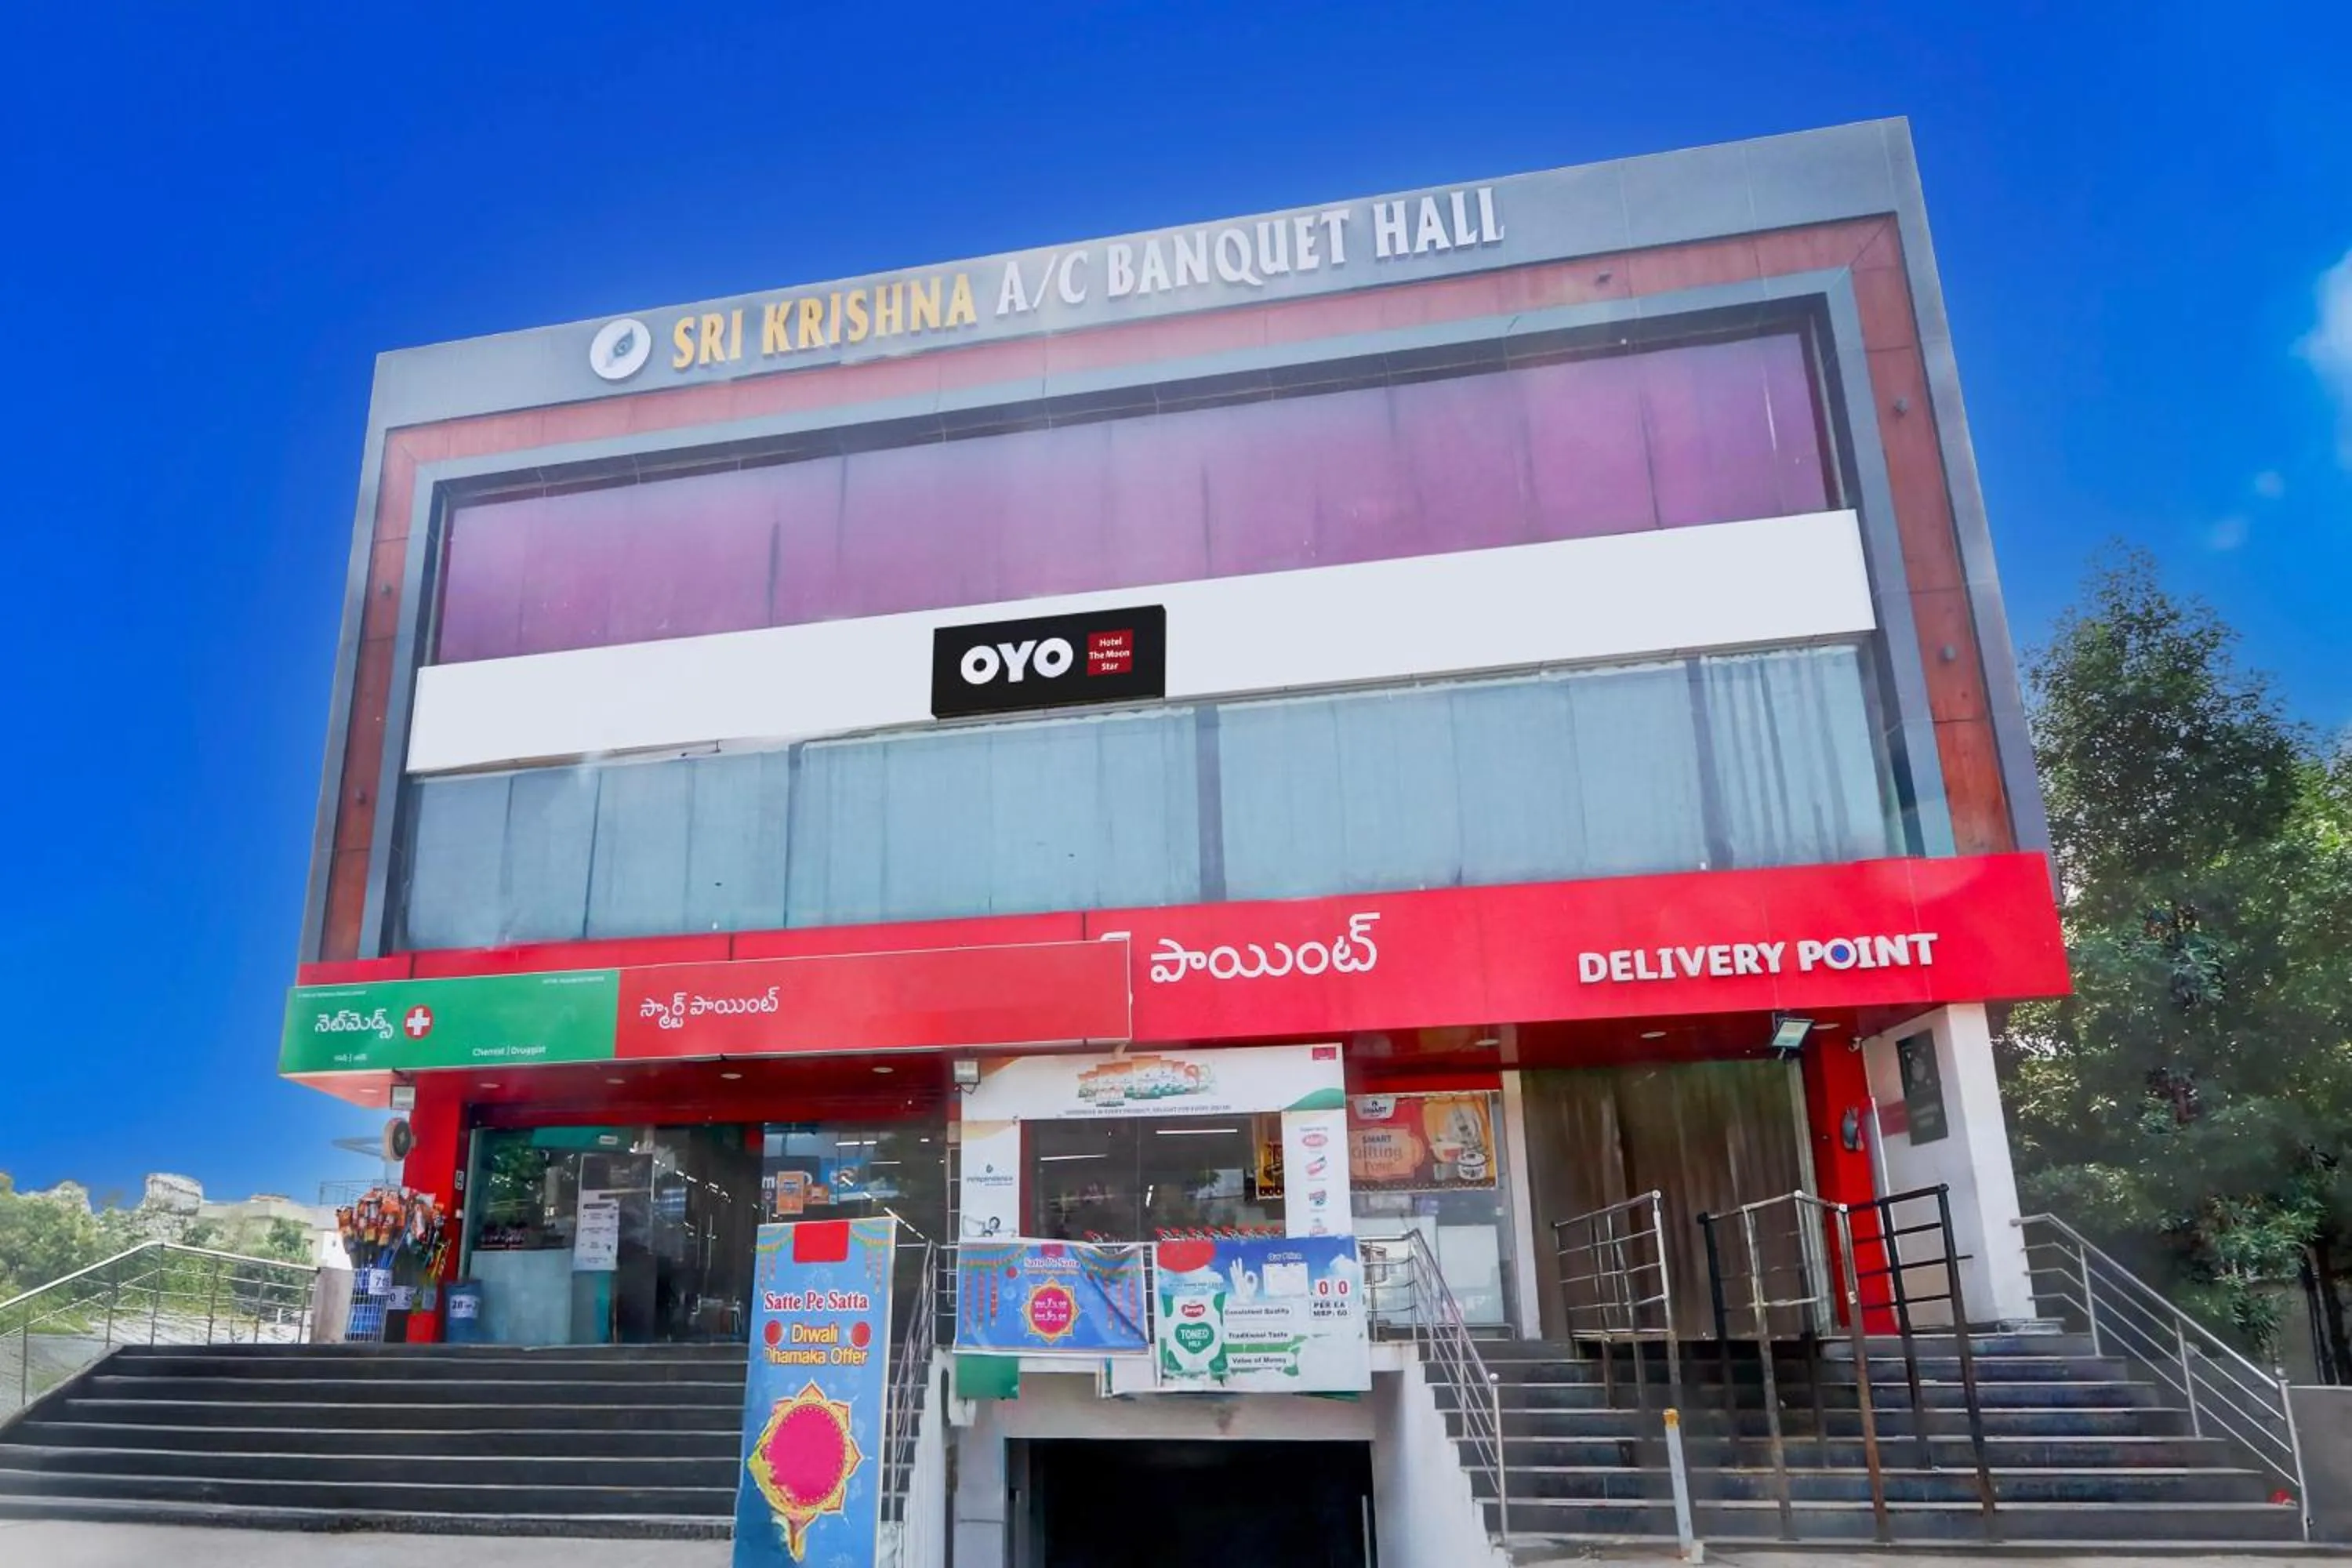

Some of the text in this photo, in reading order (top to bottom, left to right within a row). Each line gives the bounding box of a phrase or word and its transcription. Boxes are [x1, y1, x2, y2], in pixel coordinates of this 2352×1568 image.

[672, 187, 1504, 370] SRI KRISHNA A/C BANQUET HALL
[1099, 637, 1122, 647] Hotel
[960, 637, 1073, 684] OYO
[1088, 651, 1105, 659] The
[1101, 662, 1119, 671] Star
[1150, 912, 1381, 983] పాయింట్
[1577, 932, 1938, 983] DELIVERY POINT
[690, 985, 780, 1016] పాయింట్
[764, 1289, 869, 1312] Satte Pe Satta
[791, 1321, 839, 1345] Diwali
[830, 1346, 868, 1365] Offer
